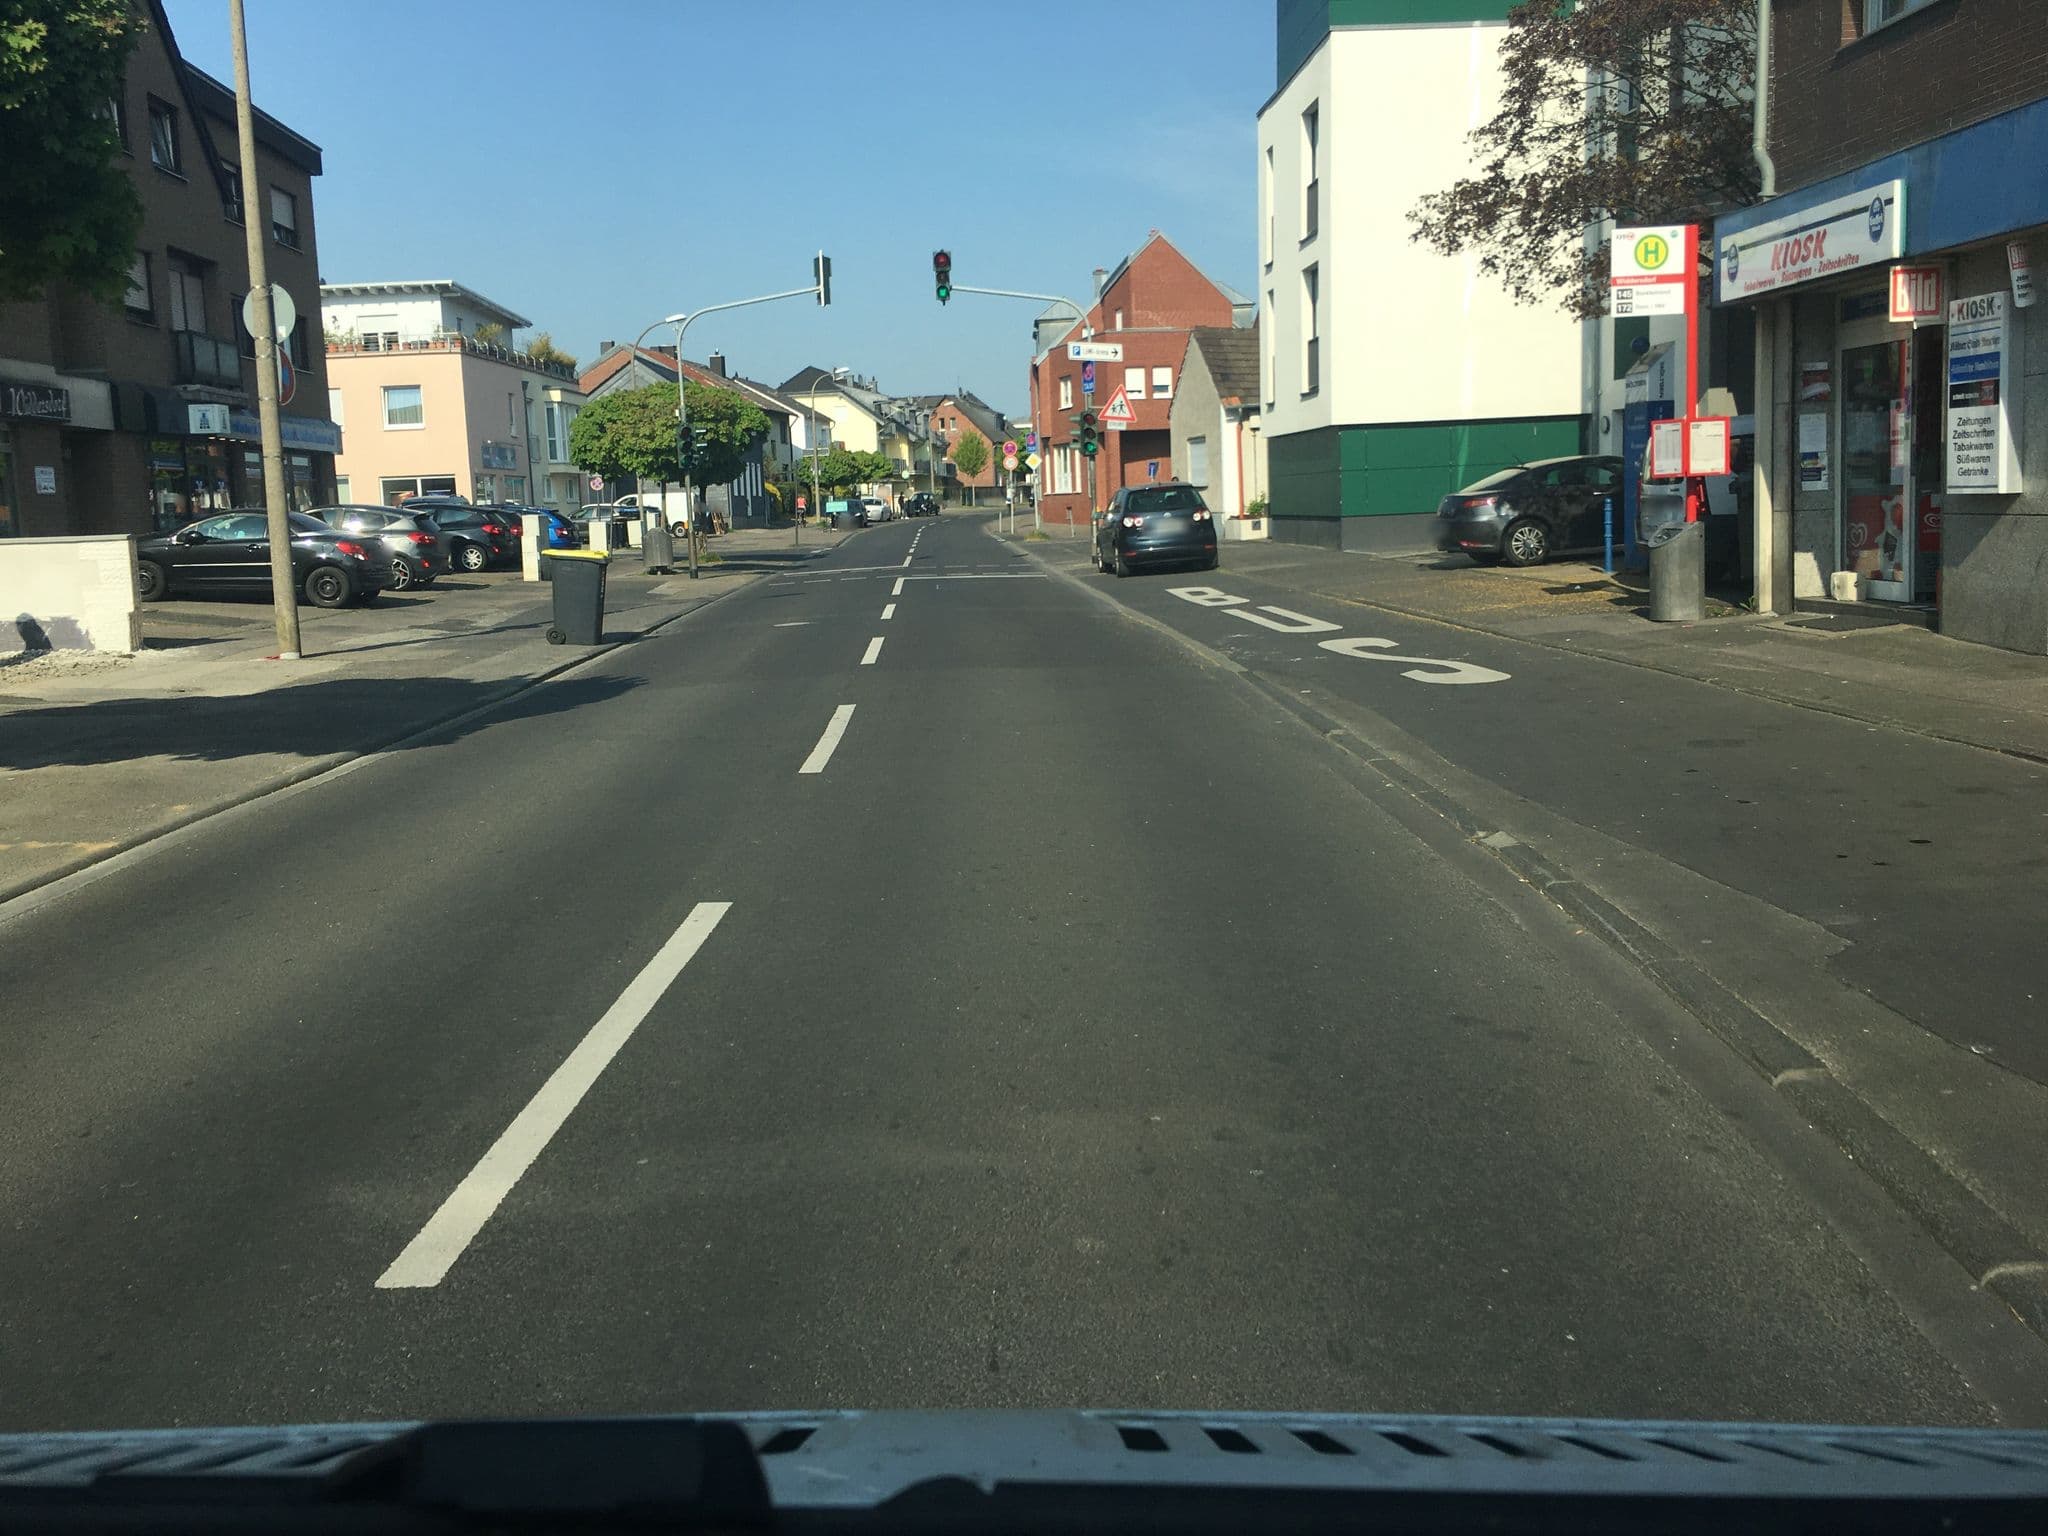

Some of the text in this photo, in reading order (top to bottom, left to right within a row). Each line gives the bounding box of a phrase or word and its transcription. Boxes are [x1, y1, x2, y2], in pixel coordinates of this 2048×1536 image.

[1643, 241, 1659, 263] H
[1770, 228, 1828, 271] KIOSK
[1818, 253, 1860, 273] Zeitschriften
[1895, 272, 1936, 313] Bild
[1617, 304, 1632, 313] 172
[1957, 296, 1996, 321] KIOSK
[1957, 416, 1992, 428] Zeitungen
[1952, 428, 1995, 440] Zeitschriften
[1953, 441, 1994, 452] Tabakwaren
[1956, 454, 1991, 464] Süßwaren
